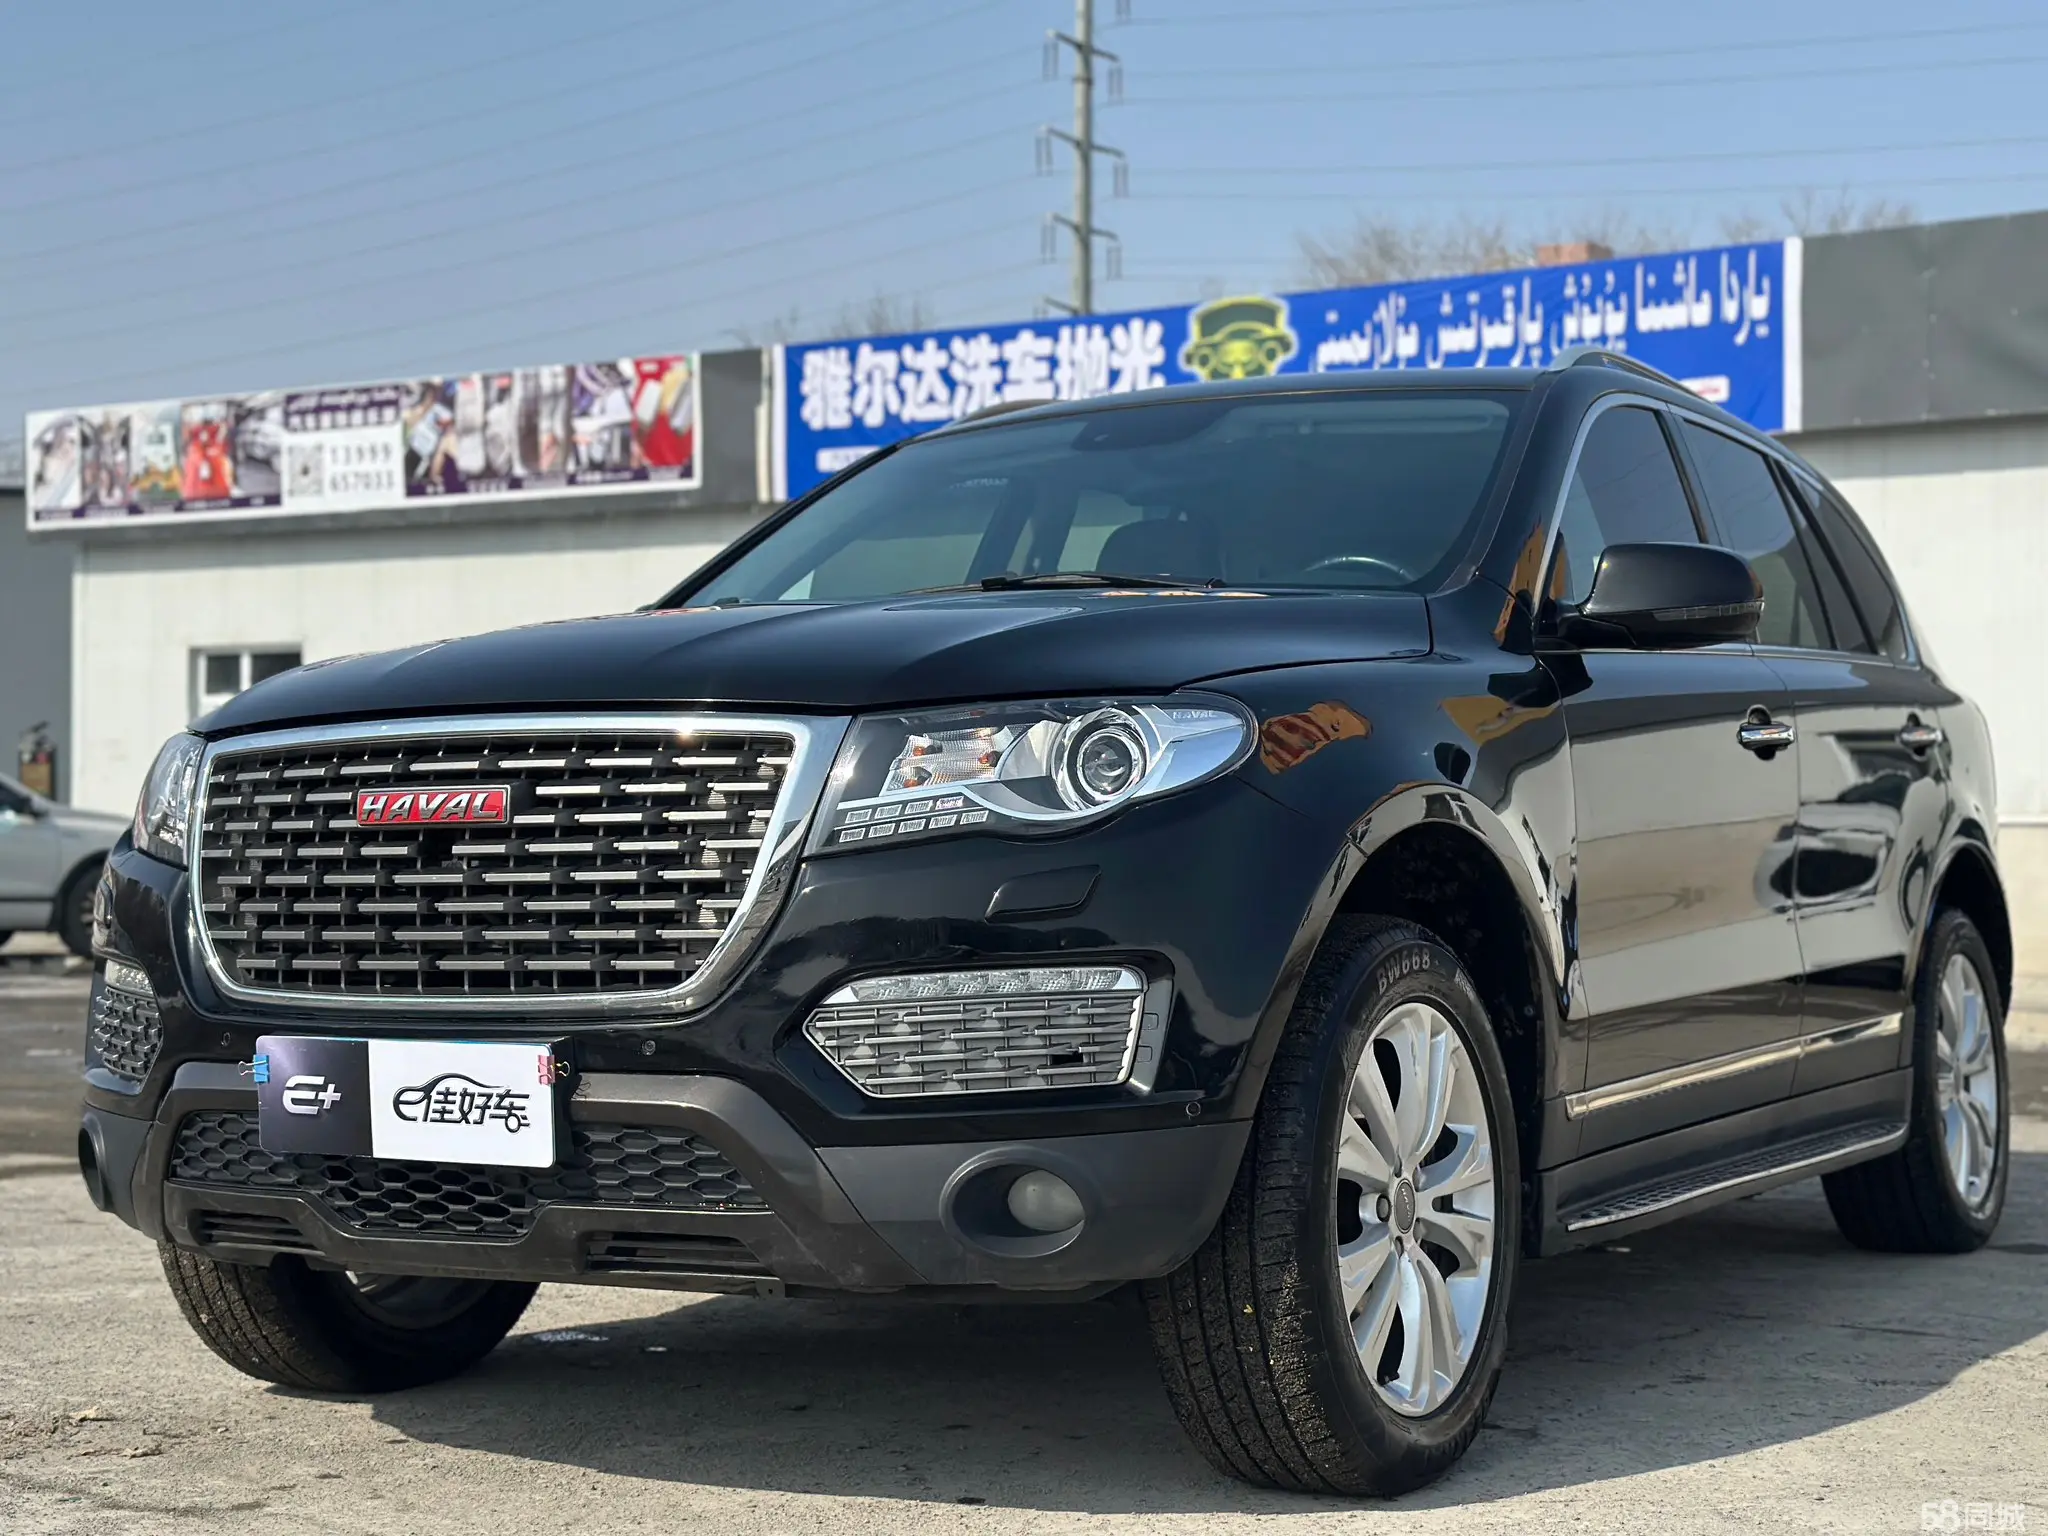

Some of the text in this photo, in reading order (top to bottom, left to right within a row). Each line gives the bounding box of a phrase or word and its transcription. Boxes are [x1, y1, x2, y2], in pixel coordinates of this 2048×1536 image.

[1635, 256, 1712, 333] ماشىنا
[801, 318, 1165, 430] 雅尔达洗车抛光
[1173, 710, 1217, 719] HAVAL
[361, 793, 498, 821] HAVAL
